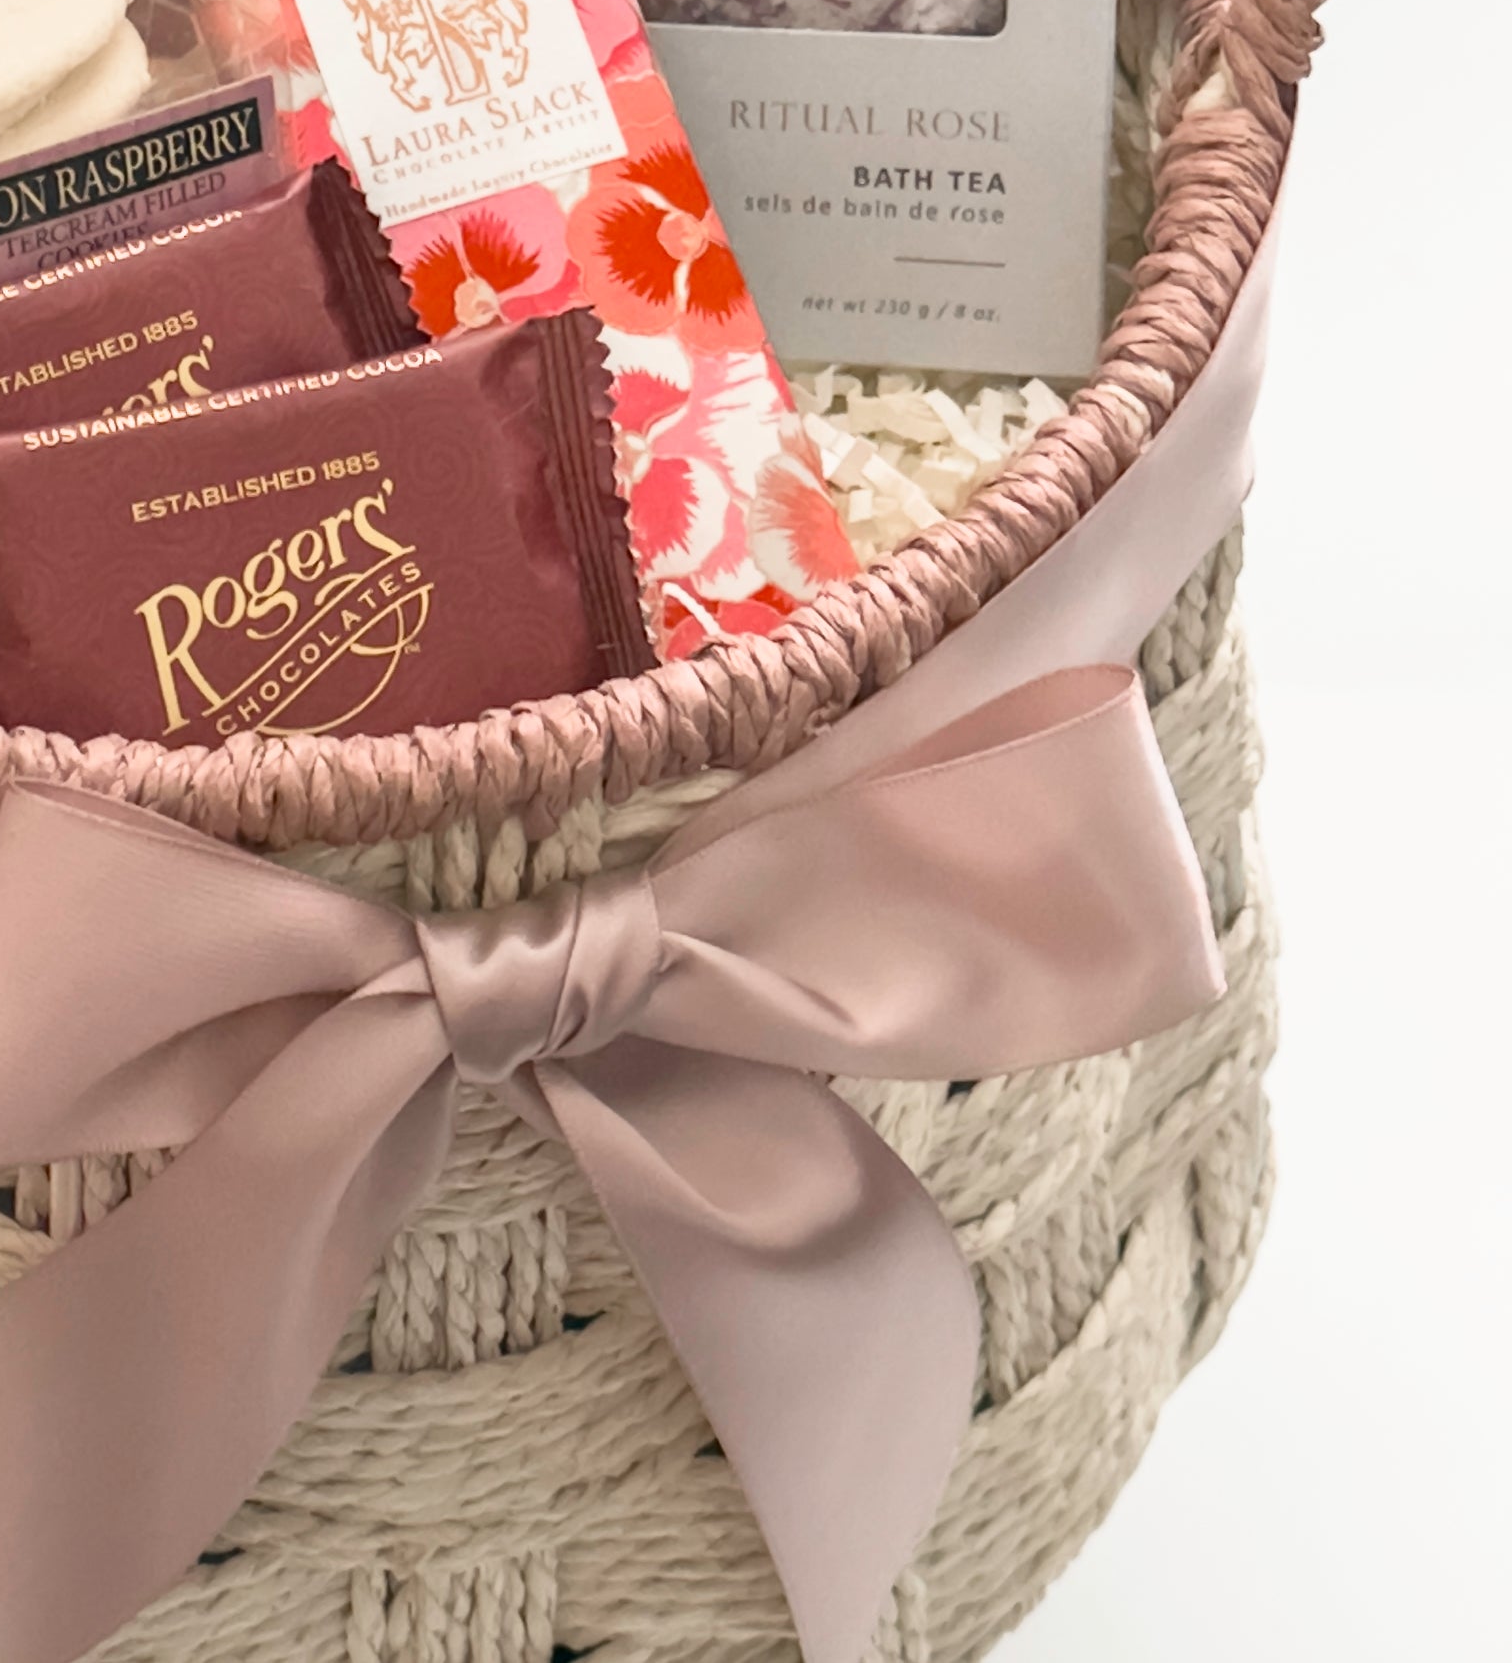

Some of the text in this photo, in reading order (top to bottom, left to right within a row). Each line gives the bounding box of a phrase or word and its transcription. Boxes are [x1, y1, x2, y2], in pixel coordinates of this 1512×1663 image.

[729, 99, 1010, 142] RITUAL ROSE
[54, 106, 254, 210] RASPBERRY
[144, 171, 226, 215] FILLED
[854, 166, 1006, 194] BATH TEA
[744, 195, 1006, 224] sels de bain de rose
[142, 309, 199, 344] 1885
[802, 297, 834, 311] net
[843, 299, 866, 314] wt
[874, 300, 911, 315] 230
[918, 304, 931, 320] g
[23, 401, 202, 451] SUSTAINABLE
[207, 370, 339, 410] CERTIFIED
[346, 347, 443, 380] COCOA
[131, 450, 381, 523] ESTABLISHED 1885
[215, 561, 422, 736] CHOCOLATES
